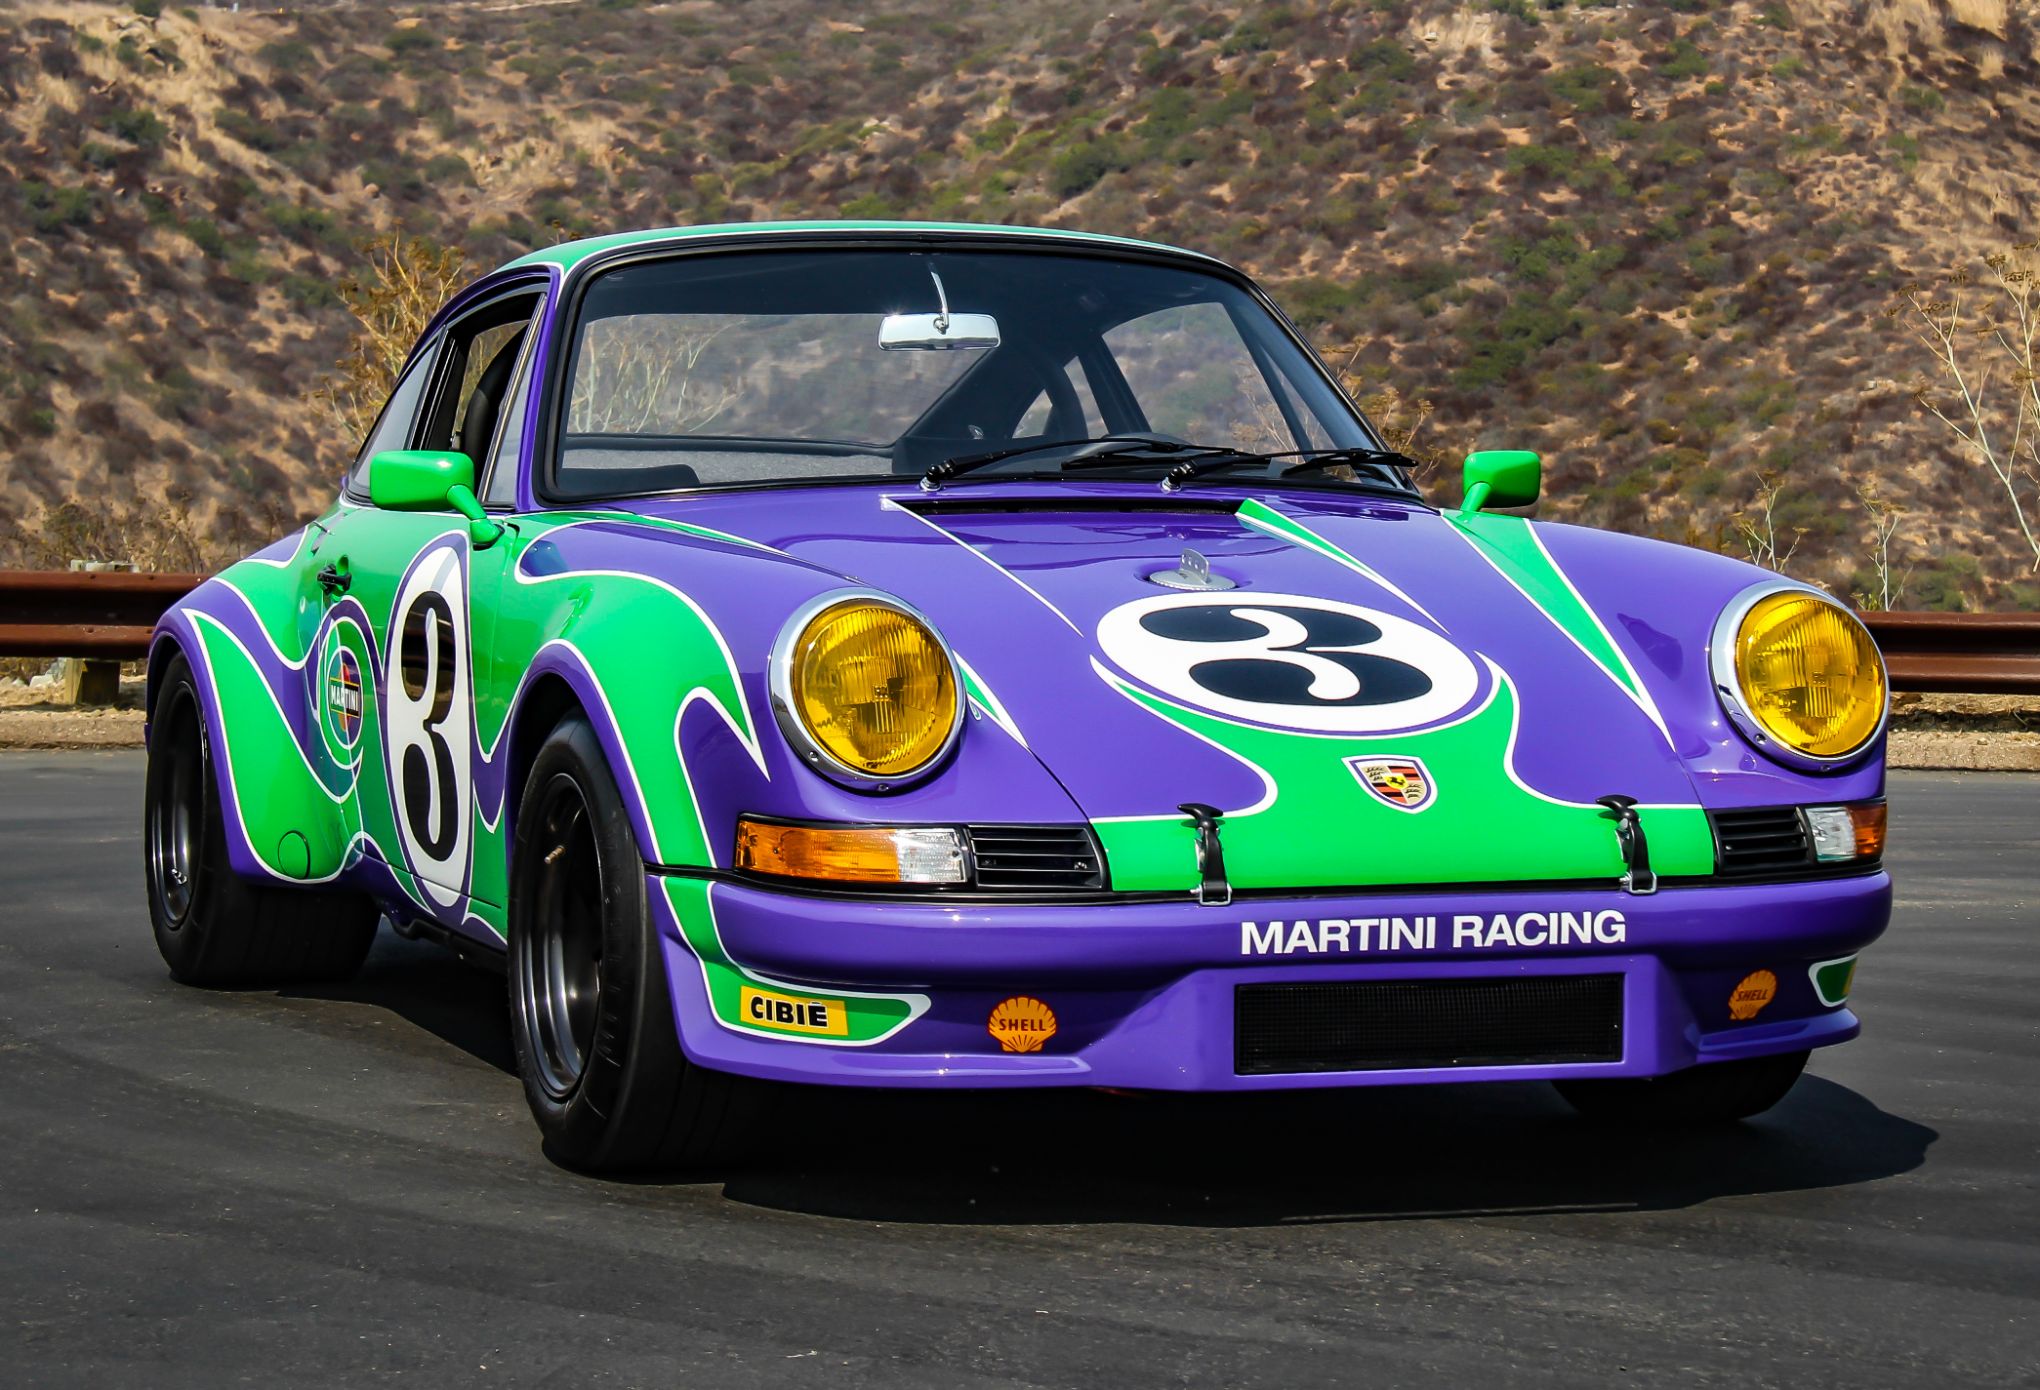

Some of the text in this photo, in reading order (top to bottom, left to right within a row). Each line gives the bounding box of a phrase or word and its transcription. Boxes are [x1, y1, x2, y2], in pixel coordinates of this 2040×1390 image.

[1139, 604, 1433, 707] 3
[331, 685, 359, 711] MARTINI
[402, 591, 459, 862] 3
[1241, 910, 1627, 955] MARTINI RACING
[1736, 989, 1769, 1002] SHELL
[998, 1018, 1047, 1032] SHELL
